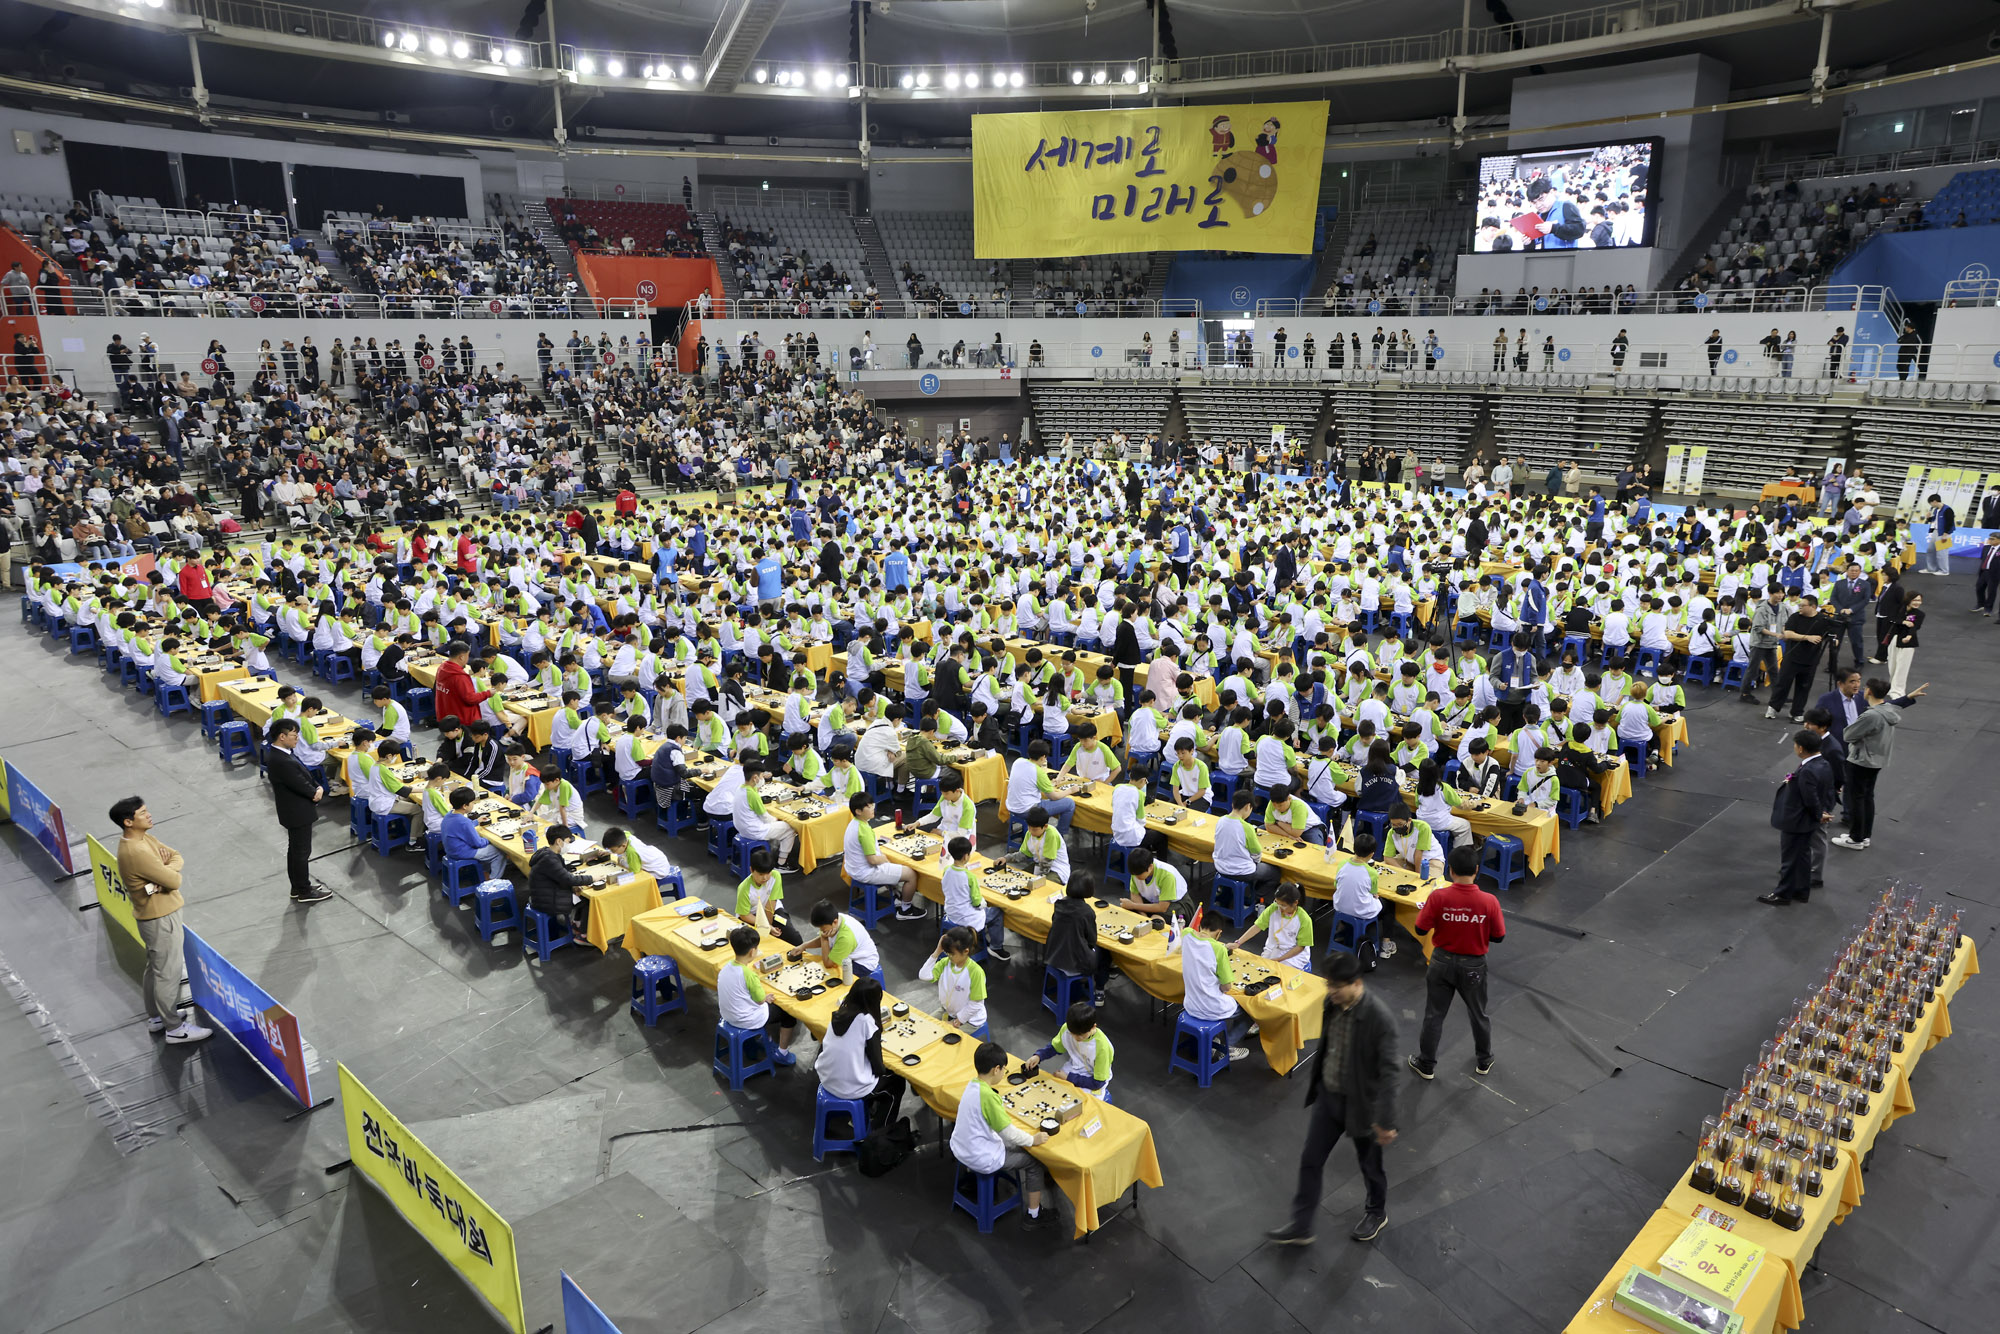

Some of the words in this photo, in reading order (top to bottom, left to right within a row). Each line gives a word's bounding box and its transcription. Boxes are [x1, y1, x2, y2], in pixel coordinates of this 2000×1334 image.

[1025, 125, 1165, 177] 세계로
[1091, 174, 1229, 228] 미래로
[640, 285, 654, 294] N3
[1235, 291, 1247, 300] E2
[924, 378, 935, 387] E1
[762, 565, 778, 574] STAFF
[1364, 776, 1378, 788] NEW
[1379, 776, 1394, 785] YORK
[1442, 912, 1470, 922] Club
[1470, 914, 1487, 924] A7
[198, 956, 287, 1057] 전국바둑대회
[362, 1110, 494, 1267] 전국바둑대회
